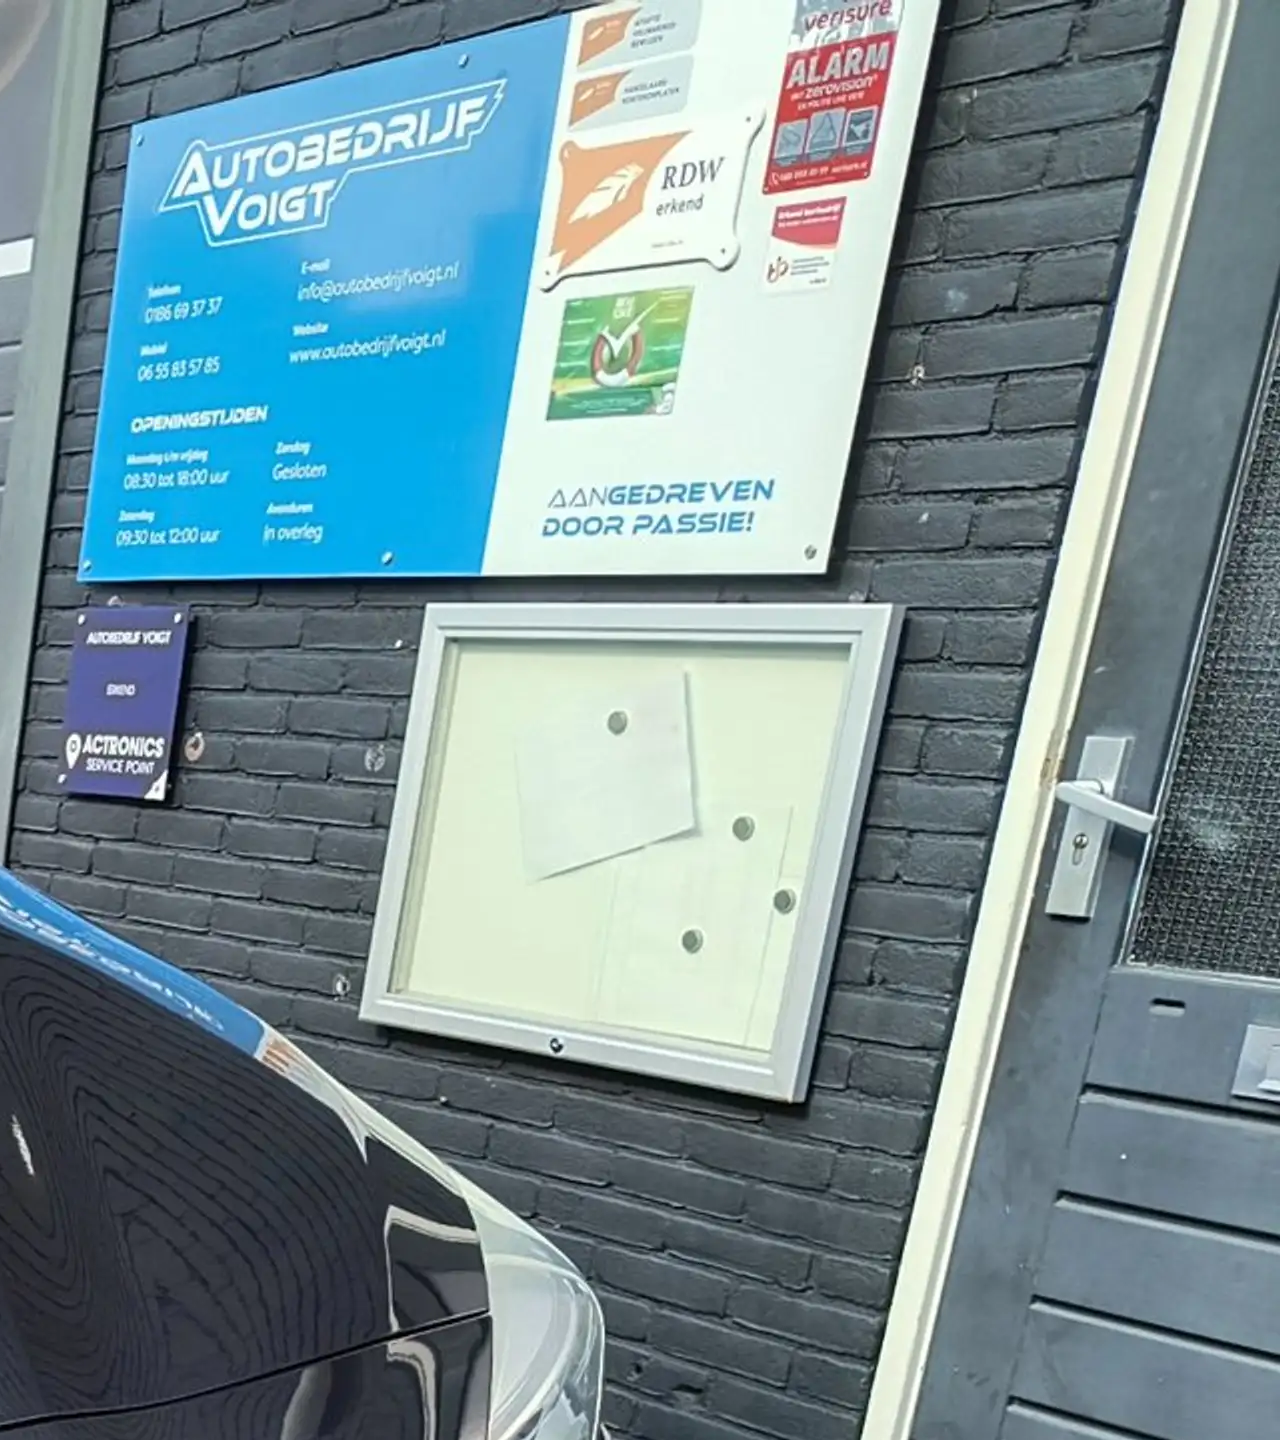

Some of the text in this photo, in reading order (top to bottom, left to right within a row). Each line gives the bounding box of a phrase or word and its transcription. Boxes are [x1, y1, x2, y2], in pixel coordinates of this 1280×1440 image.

[786, 40, 891, 90] ALARM
[172, 95, 488, 198] AUTOBEDRIJF
[661, 156, 726, 190] RDW
[203, 179, 338, 237] VOIGT
[655, 193, 705, 217] erkend
[298, 260, 460, 303] info@autobedrijfvoigt.nl
[289, 328, 447, 364] www.autobedrijfvoigt.nl
[130, 405, 269, 433] OPENINGSTIJDEN
[124, 468, 230, 491] 08:30 tot 18:00 uur
[272, 461, 328, 481] Gesloten
[548, 478, 775, 509] AANGEDREVEN
[150, 529, 166, 545] tot
[168, 527, 199, 544] 12:00
[199, 528, 221, 544] uur
[277, 522, 324, 544] overleg
[542, 511, 755, 537] DOOR PASSIE!
[86, 630, 172, 645] AUTOBEDRIJF VOIGT
[82, 734, 165, 758] ACTRONICS
[85, 759, 155, 775] SERVICE POINT
